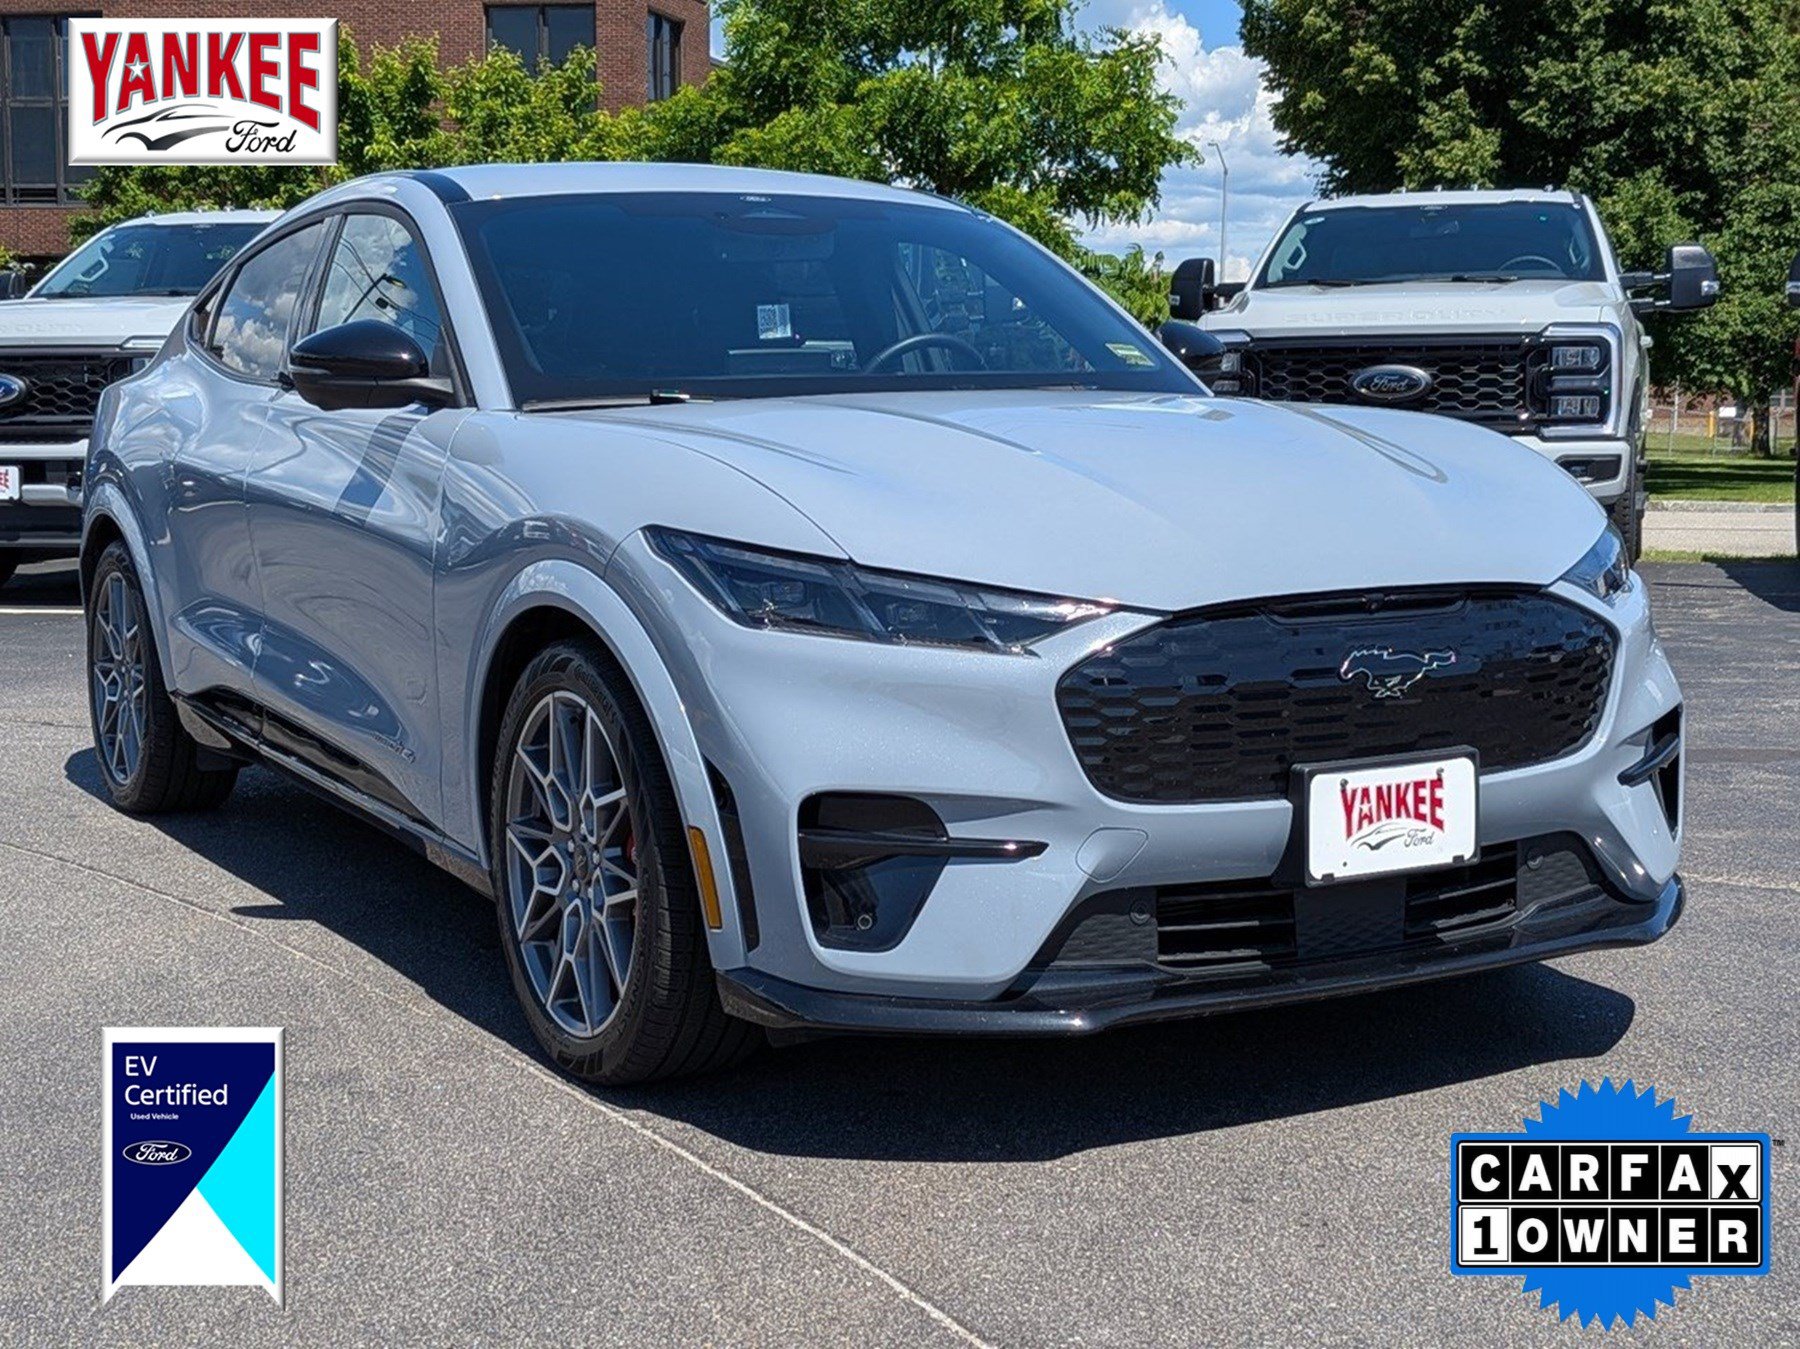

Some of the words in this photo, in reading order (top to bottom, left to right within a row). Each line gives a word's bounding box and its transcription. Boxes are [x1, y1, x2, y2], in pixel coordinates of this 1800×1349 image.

[1369, 374, 1407, 392] Ford
[1340, 778, 1445, 842] YANKEE
[1403, 828, 1435, 848] Ford
